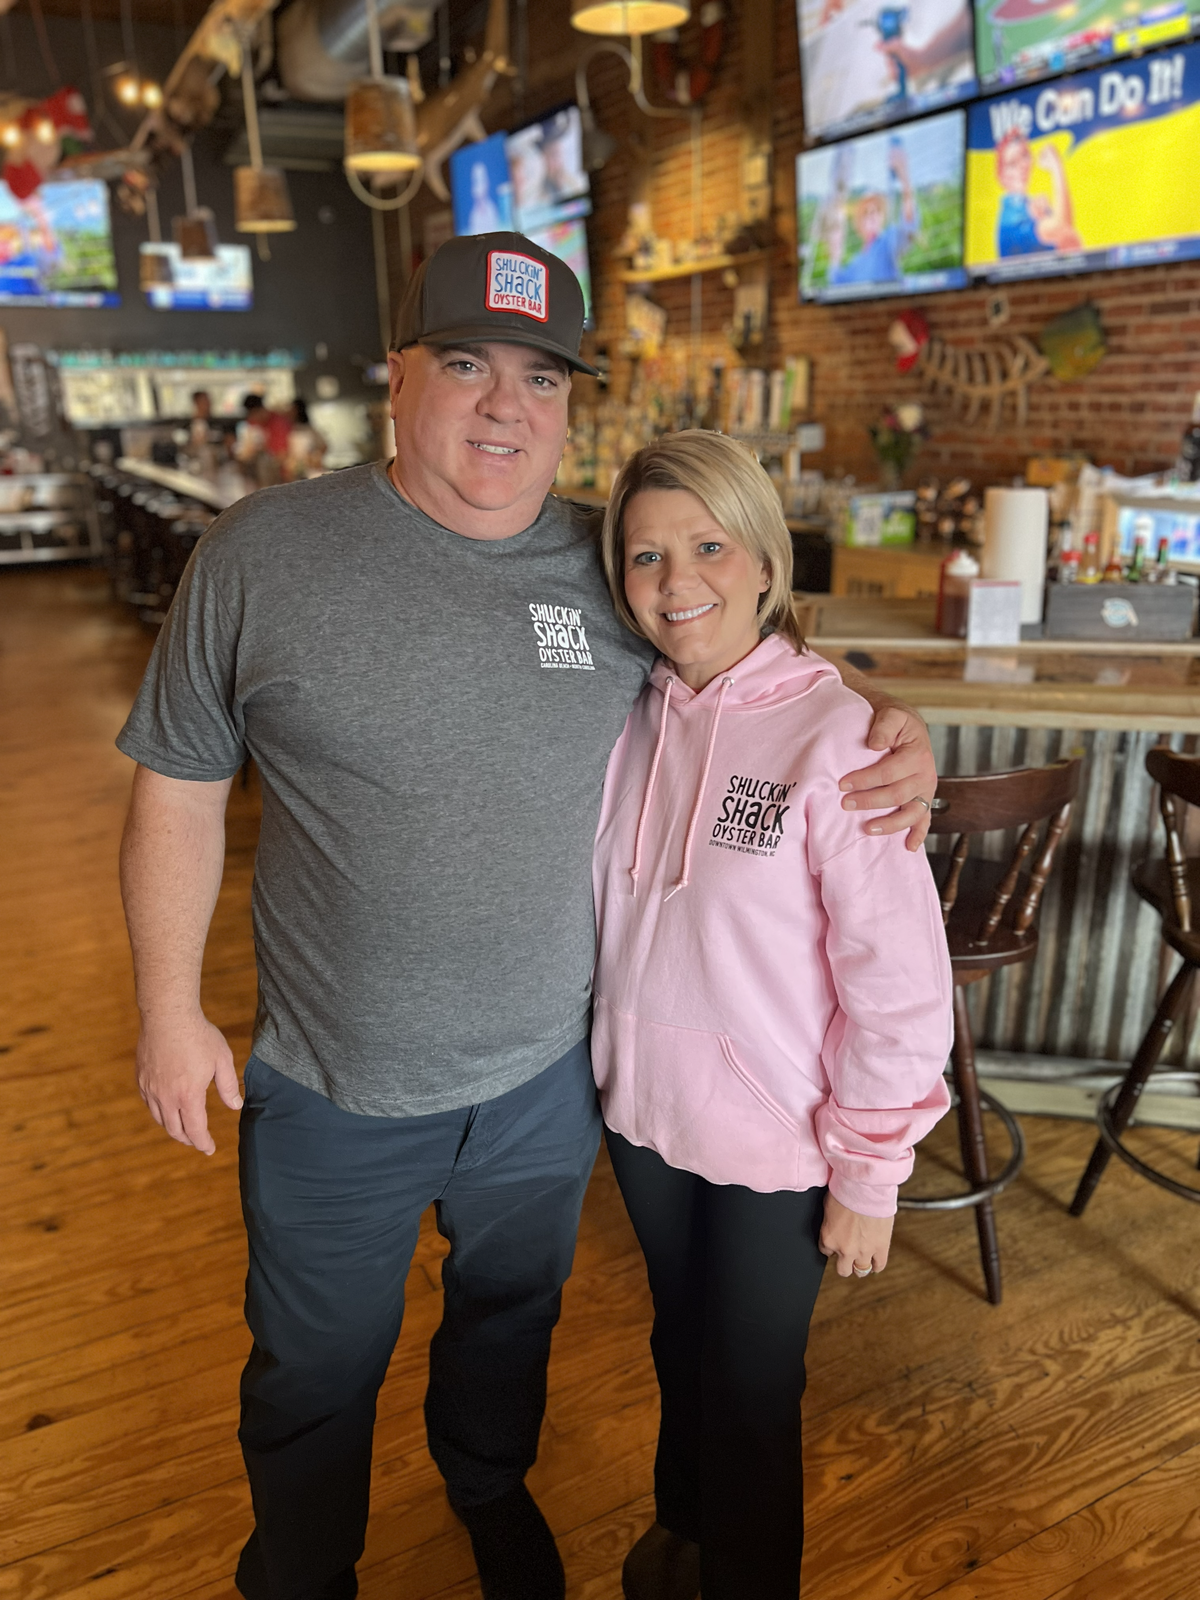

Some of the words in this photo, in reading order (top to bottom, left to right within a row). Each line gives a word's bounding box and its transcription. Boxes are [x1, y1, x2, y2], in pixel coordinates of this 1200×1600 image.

[990, 99, 1033, 144] We
[1035, 87, 1095, 132] Can
[1100, 71, 1144, 116] Do
[1147, 53, 1186, 105] It!
[493, 293, 526, 308] OYSTER
[527, 299, 542, 315] BAR
[539, 648, 576, 663] OYSTER
[575, 650, 594, 665] BAR
[708, 839, 737, 852] DOWNTOWN
[712, 823, 757, 846] OYSTER
[757, 831, 782, 850] BAR
